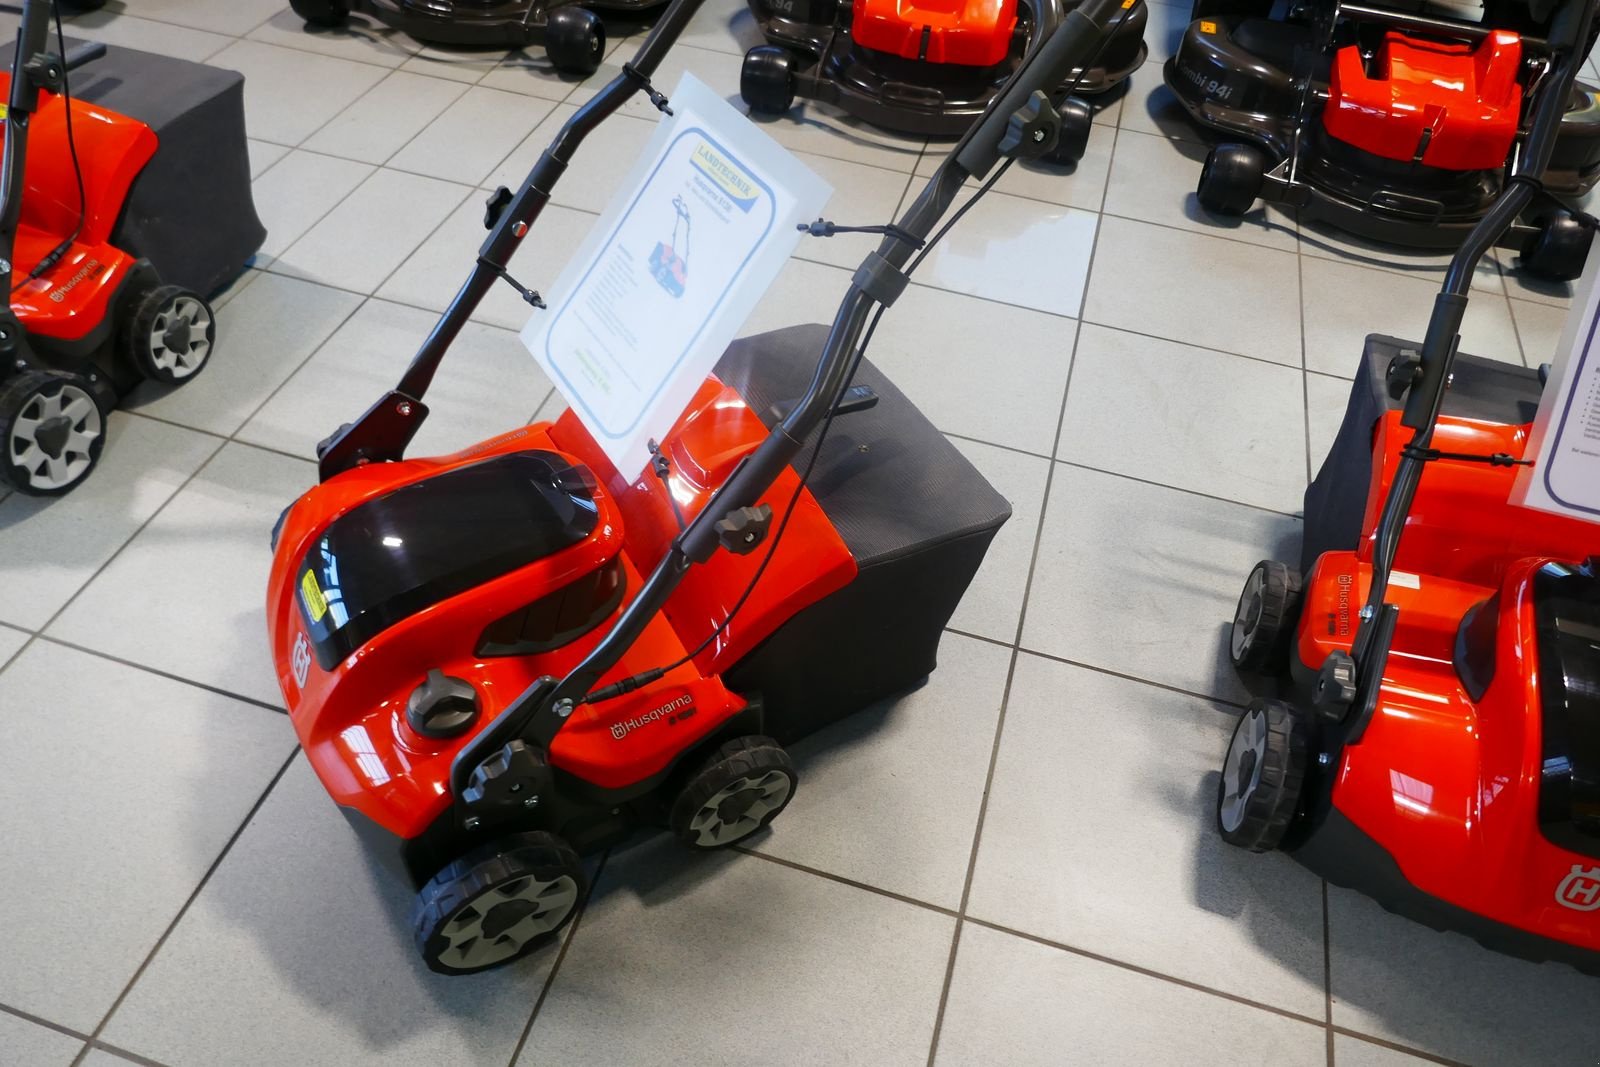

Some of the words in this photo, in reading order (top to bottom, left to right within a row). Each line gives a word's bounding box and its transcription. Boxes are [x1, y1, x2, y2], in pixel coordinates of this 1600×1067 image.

[1208, 81, 1233, 100] 94i
[696, 144, 752, 197] LANDTECHNIK
[62, 258, 98, 293] Husqvarna
[1339, 584, 1350, 636] Husqvarna
[624, 694, 692, 731] Husqvarna
